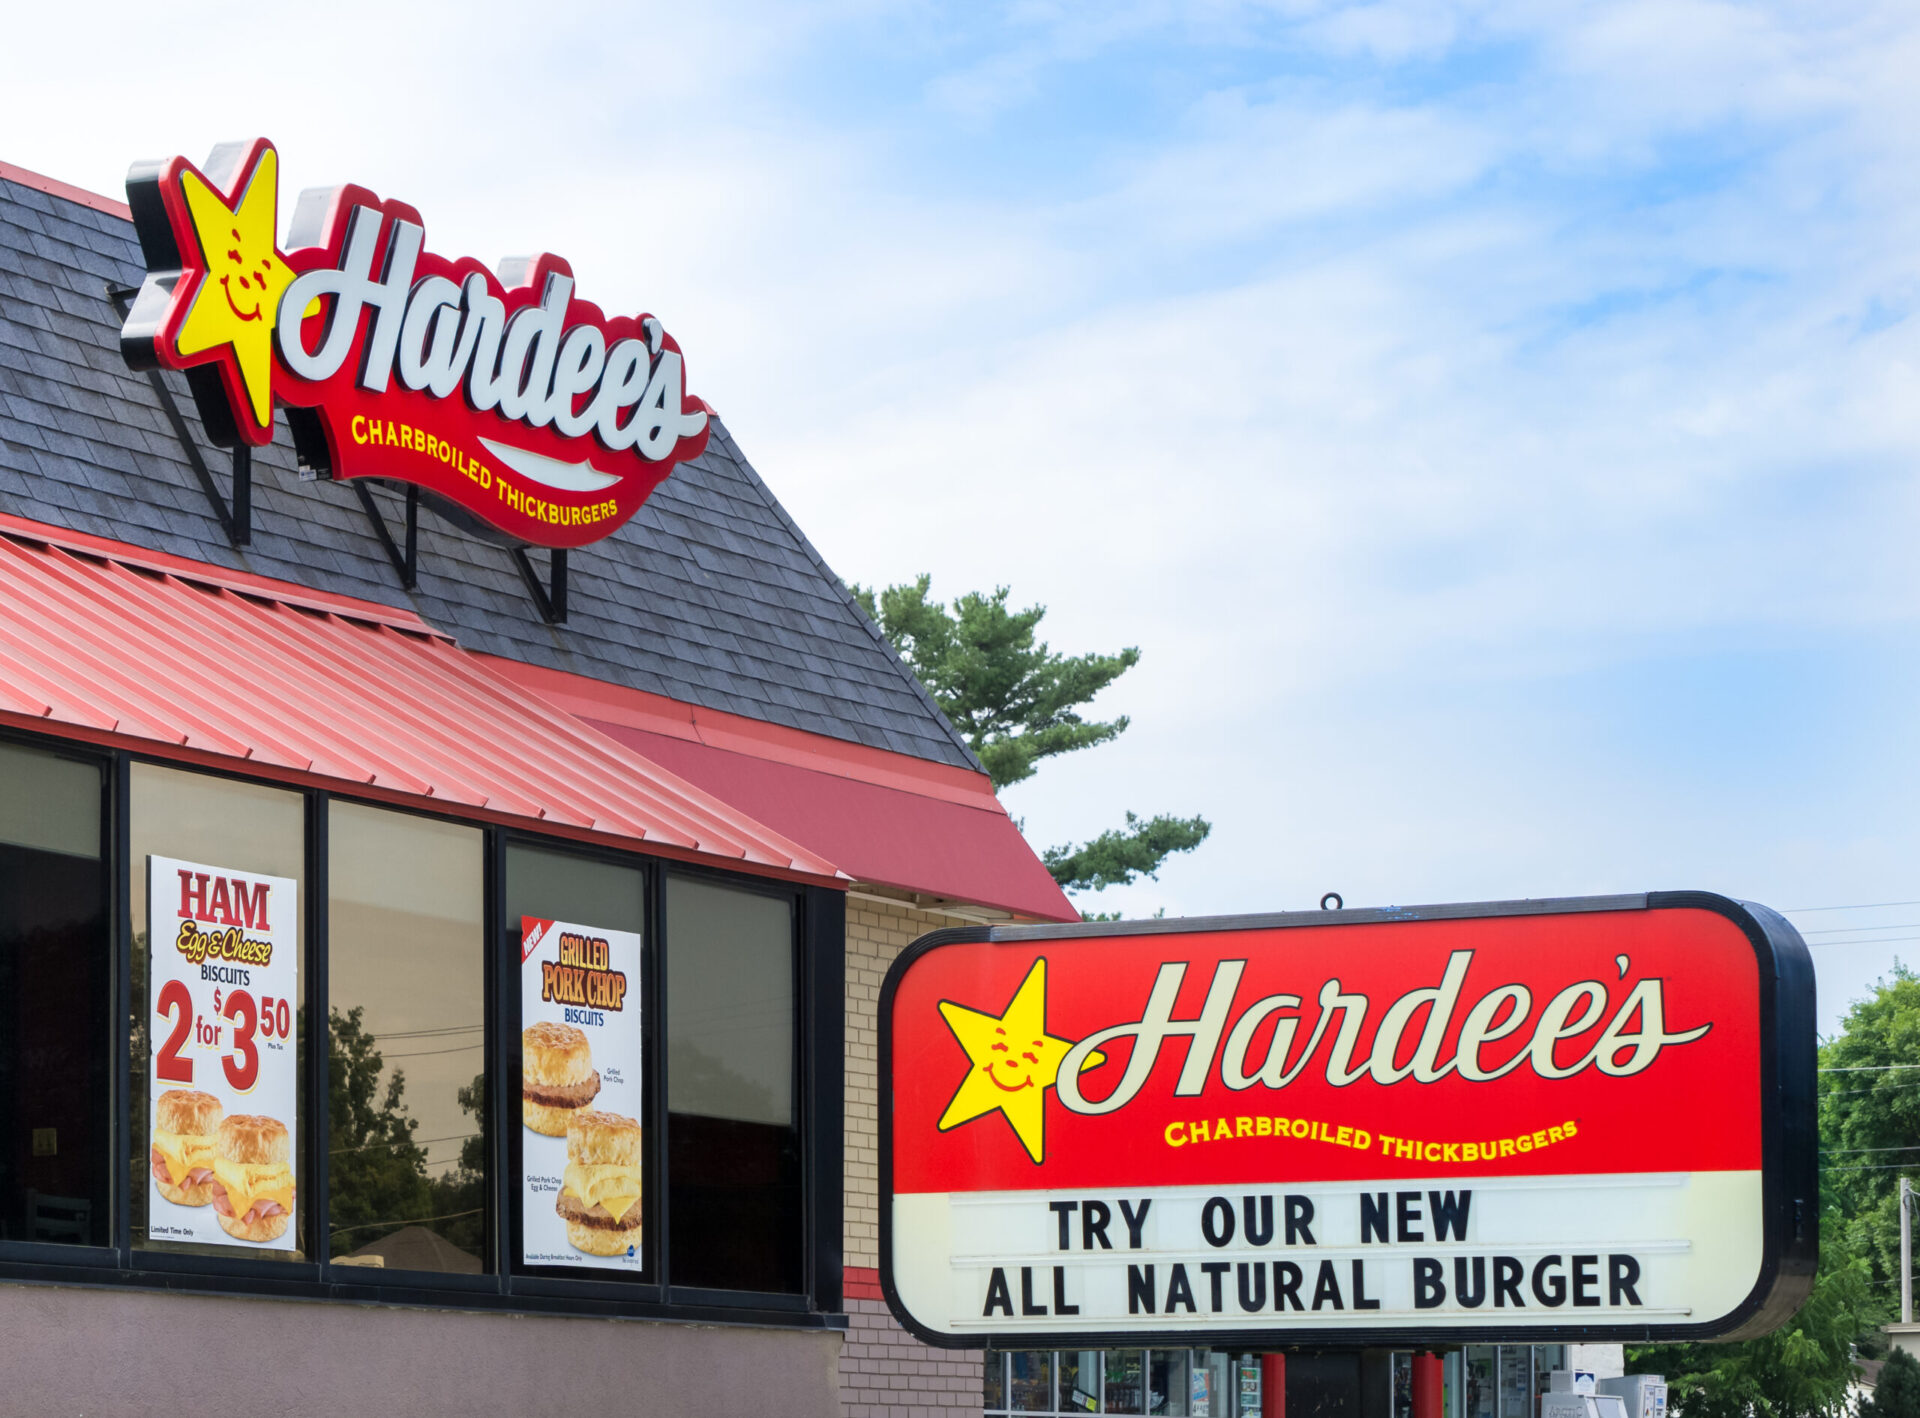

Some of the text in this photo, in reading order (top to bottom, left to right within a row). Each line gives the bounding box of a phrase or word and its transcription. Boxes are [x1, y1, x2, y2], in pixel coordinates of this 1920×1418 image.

[275, 204, 708, 462] Hardee's
[352, 415, 618, 527] CHARBROILED THICKBURGERS
[177, 868, 270, 931] HAM
[523, 922, 543, 956] NEW!
[560, 935, 609, 971] GRILLED
[200, 964, 250, 986] BISCUITS
[542, 963, 626, 1008] PORK CHOP
[156, 979, 194, 1083] 2
[196, 1015, 222, 1047] for
[565, 1007, 604, 1026] BISCUITS
[1055, 949, 1712, 1116] Hardee's
[606, 1067, 621, 1076] Grilled
[613, 1076, 624, 1084] Chop
[1164, 1115, 1578, 1162] CHARBROILED THICKBURGERS
[526, 1175, 540, 1183] Grilled
[531, 1184, 539, 1192] Egg
[151, 1225, 193, 1236] Limited Time Only
[1050, 1190, 1472, 1251] TRY OUR NEW
[983, 1254, 1642, 1317] ALL NATURAL BURGER
